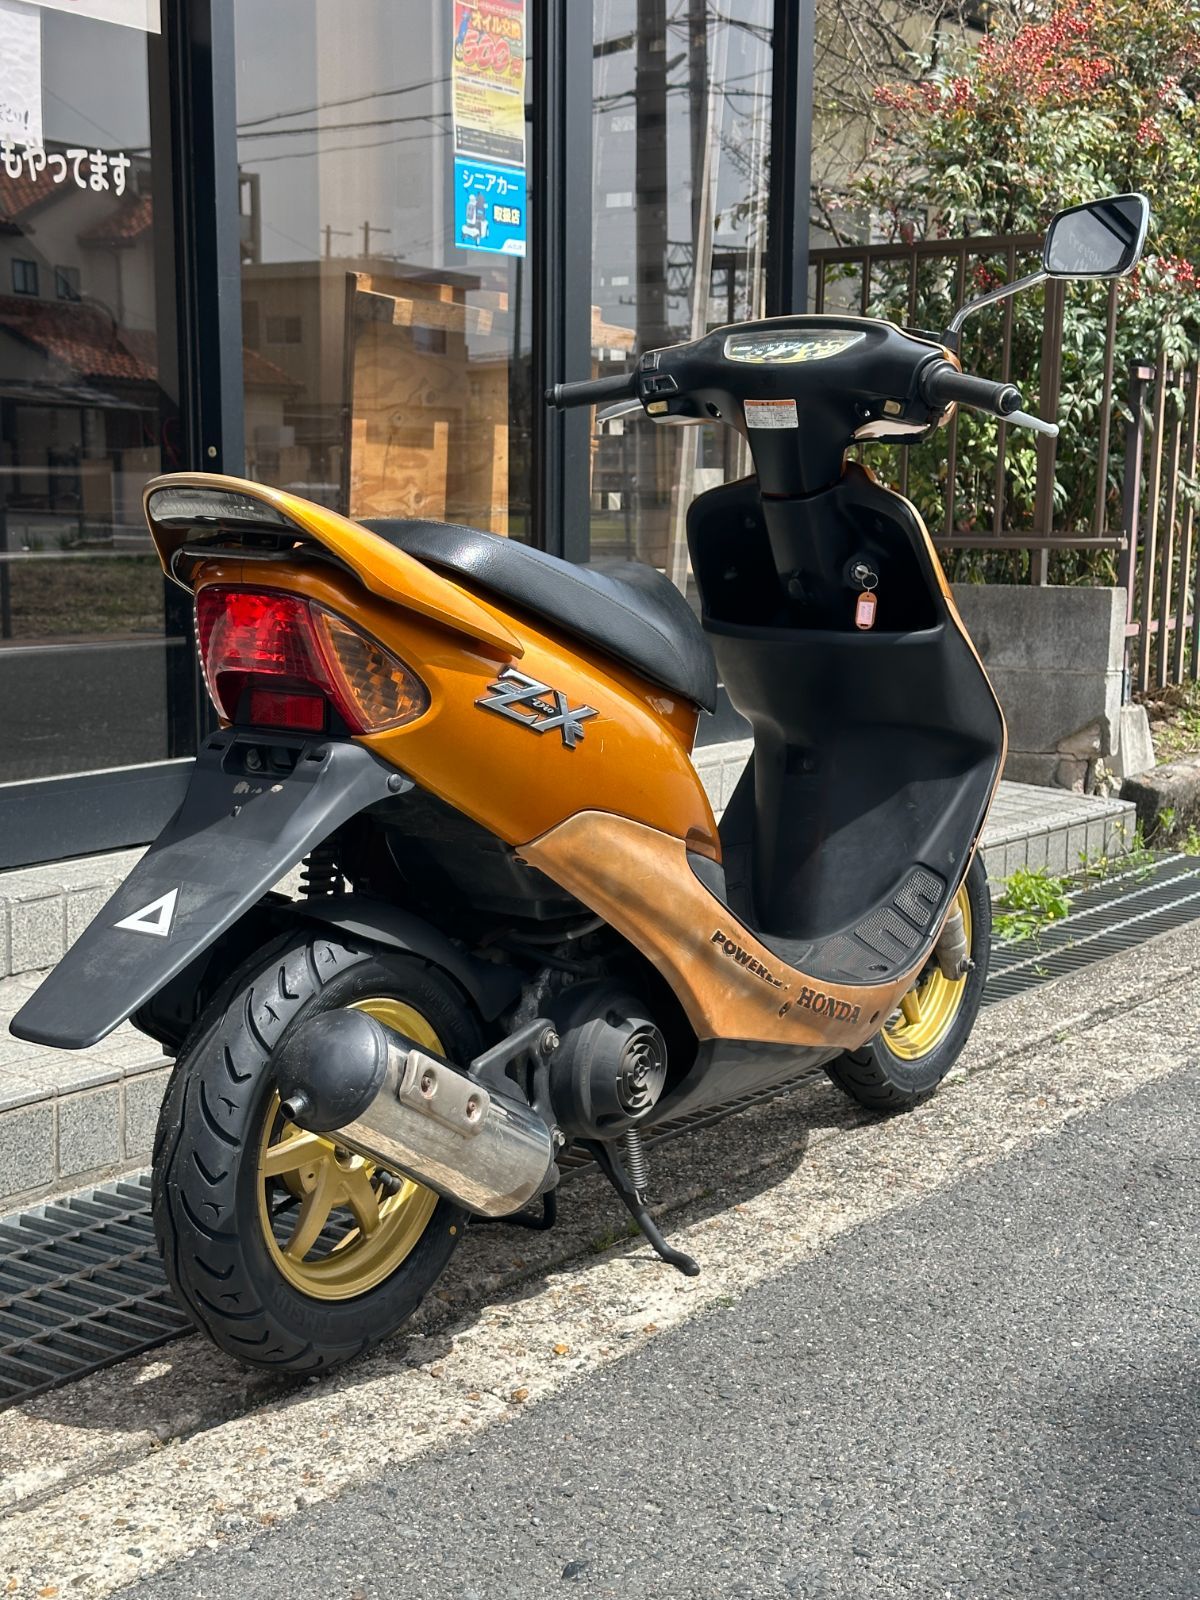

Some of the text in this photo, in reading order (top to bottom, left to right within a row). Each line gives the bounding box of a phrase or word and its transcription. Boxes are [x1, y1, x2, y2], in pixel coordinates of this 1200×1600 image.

[0, 134, 131, 196] もやってます
[462, 169, 519, 195] シニアカー
[473, 666, 600, 750] ZX
[532, 698, 555, 714] Dio
[797, 985, 862, 1025] HONDA
